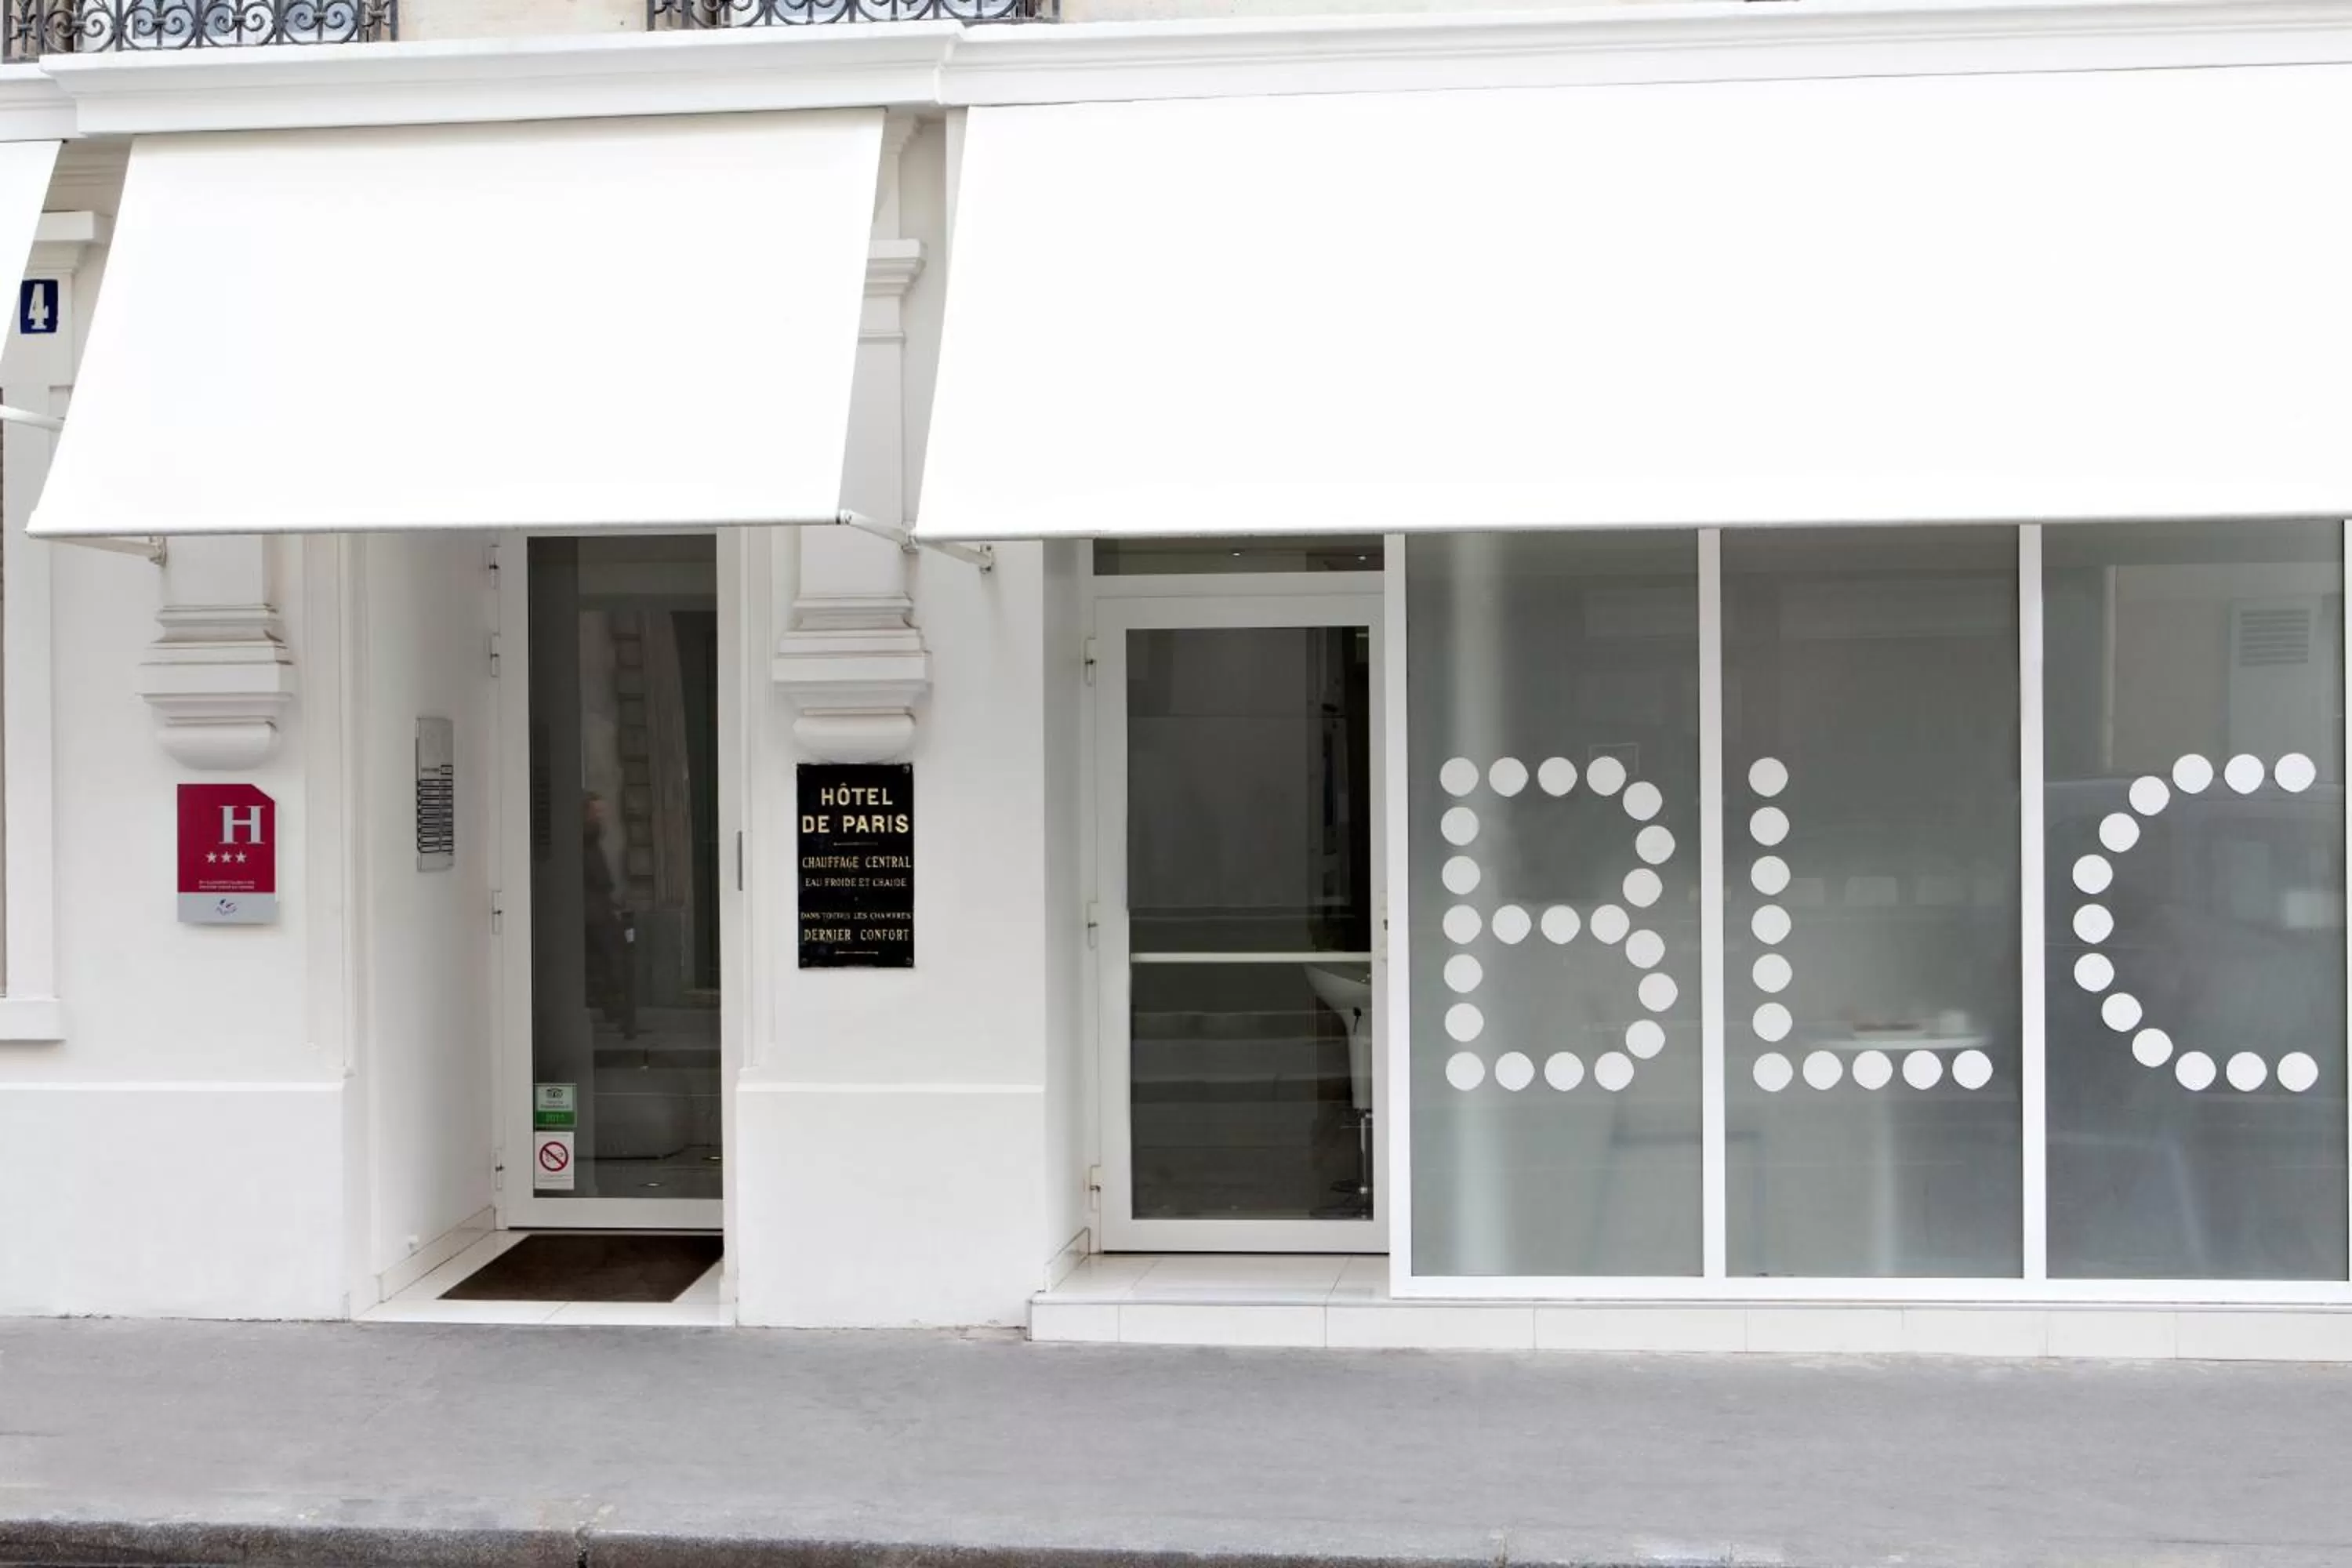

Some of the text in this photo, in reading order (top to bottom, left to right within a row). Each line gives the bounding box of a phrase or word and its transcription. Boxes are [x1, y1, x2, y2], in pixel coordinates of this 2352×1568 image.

[27, 283, 49, 330] 4
[821, 782, 893, 806] HÔTEL
[218, 804, 266, 844] H
[802, 814, 909, 833] DE PARIS
[802, 855, 911, 868] CHAUFFAGE CENTRAL
[824, 877, 857, 887] FROIDE
[858, 877, 869, 887] ET
[804, 928, 910, 942] DERNIER CONFORT
